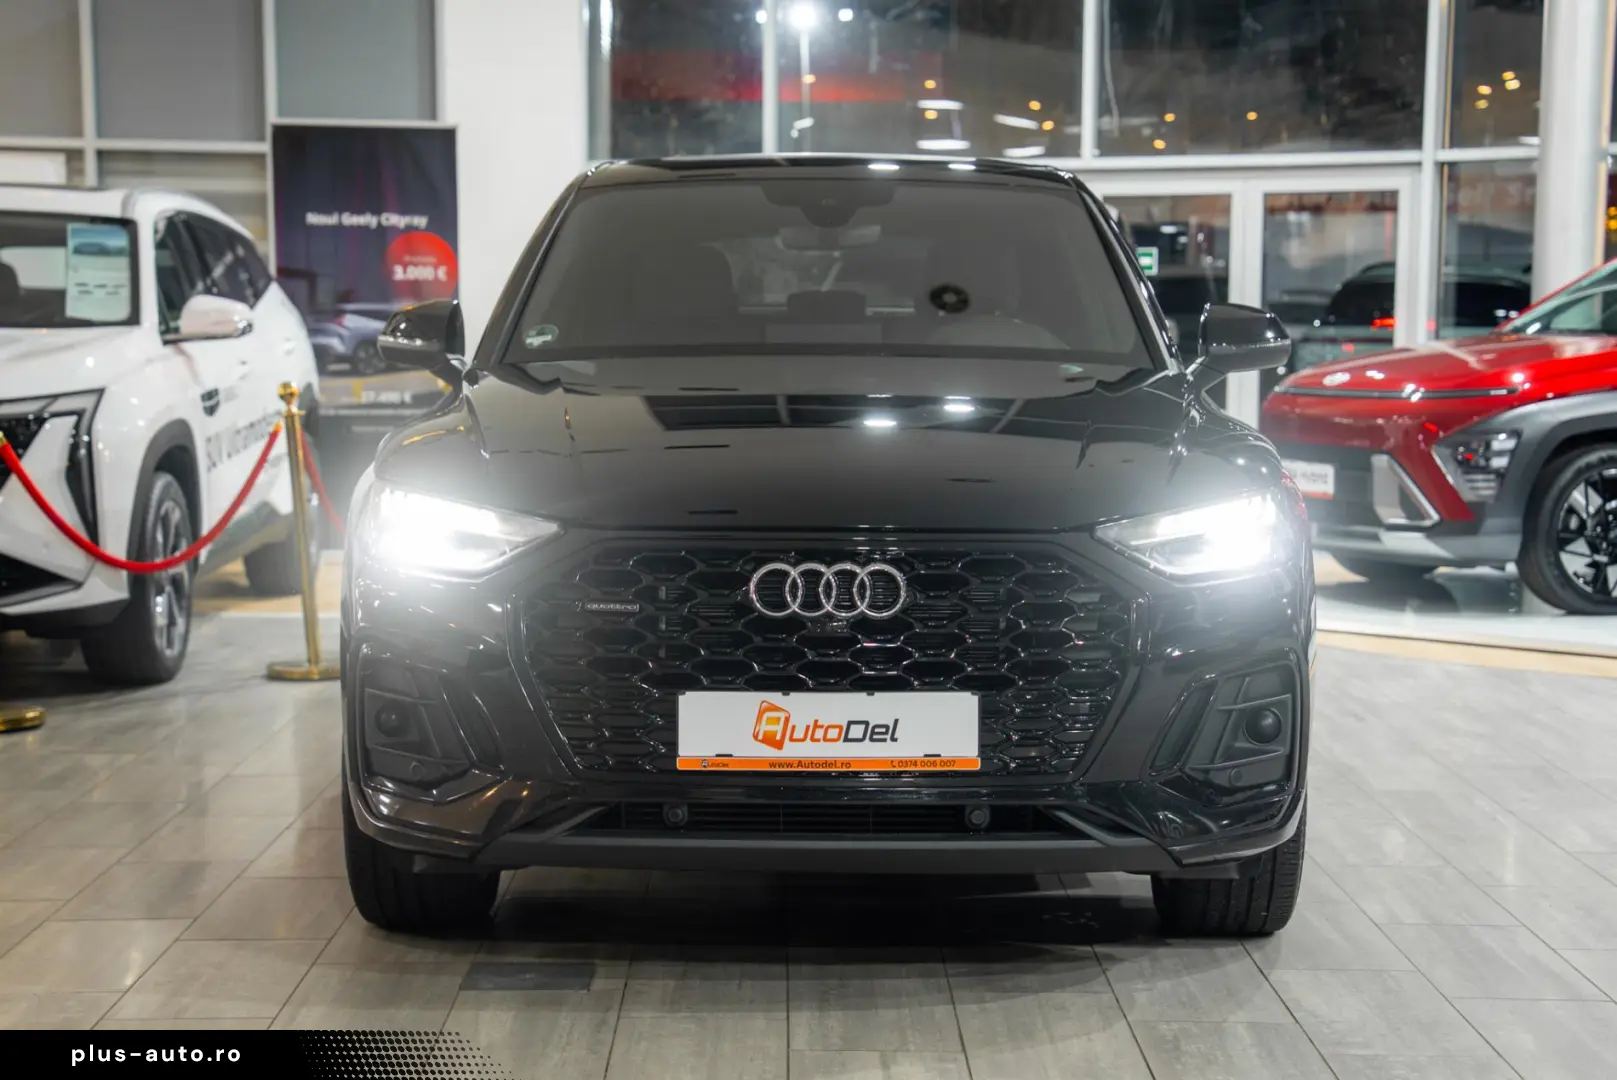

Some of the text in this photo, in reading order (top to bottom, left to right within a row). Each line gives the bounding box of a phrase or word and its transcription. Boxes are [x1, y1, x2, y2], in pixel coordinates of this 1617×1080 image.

[305, 212, 339, 225] Noul
[341, 212, 379, 229] Geely
[585, 603, 637, 611] quattro
[754, 703, 899, 746] AutoDel
[768, 760, 851, 769] www.Autodel.ro
[897, 760, 956, 768] 0374 006 007
